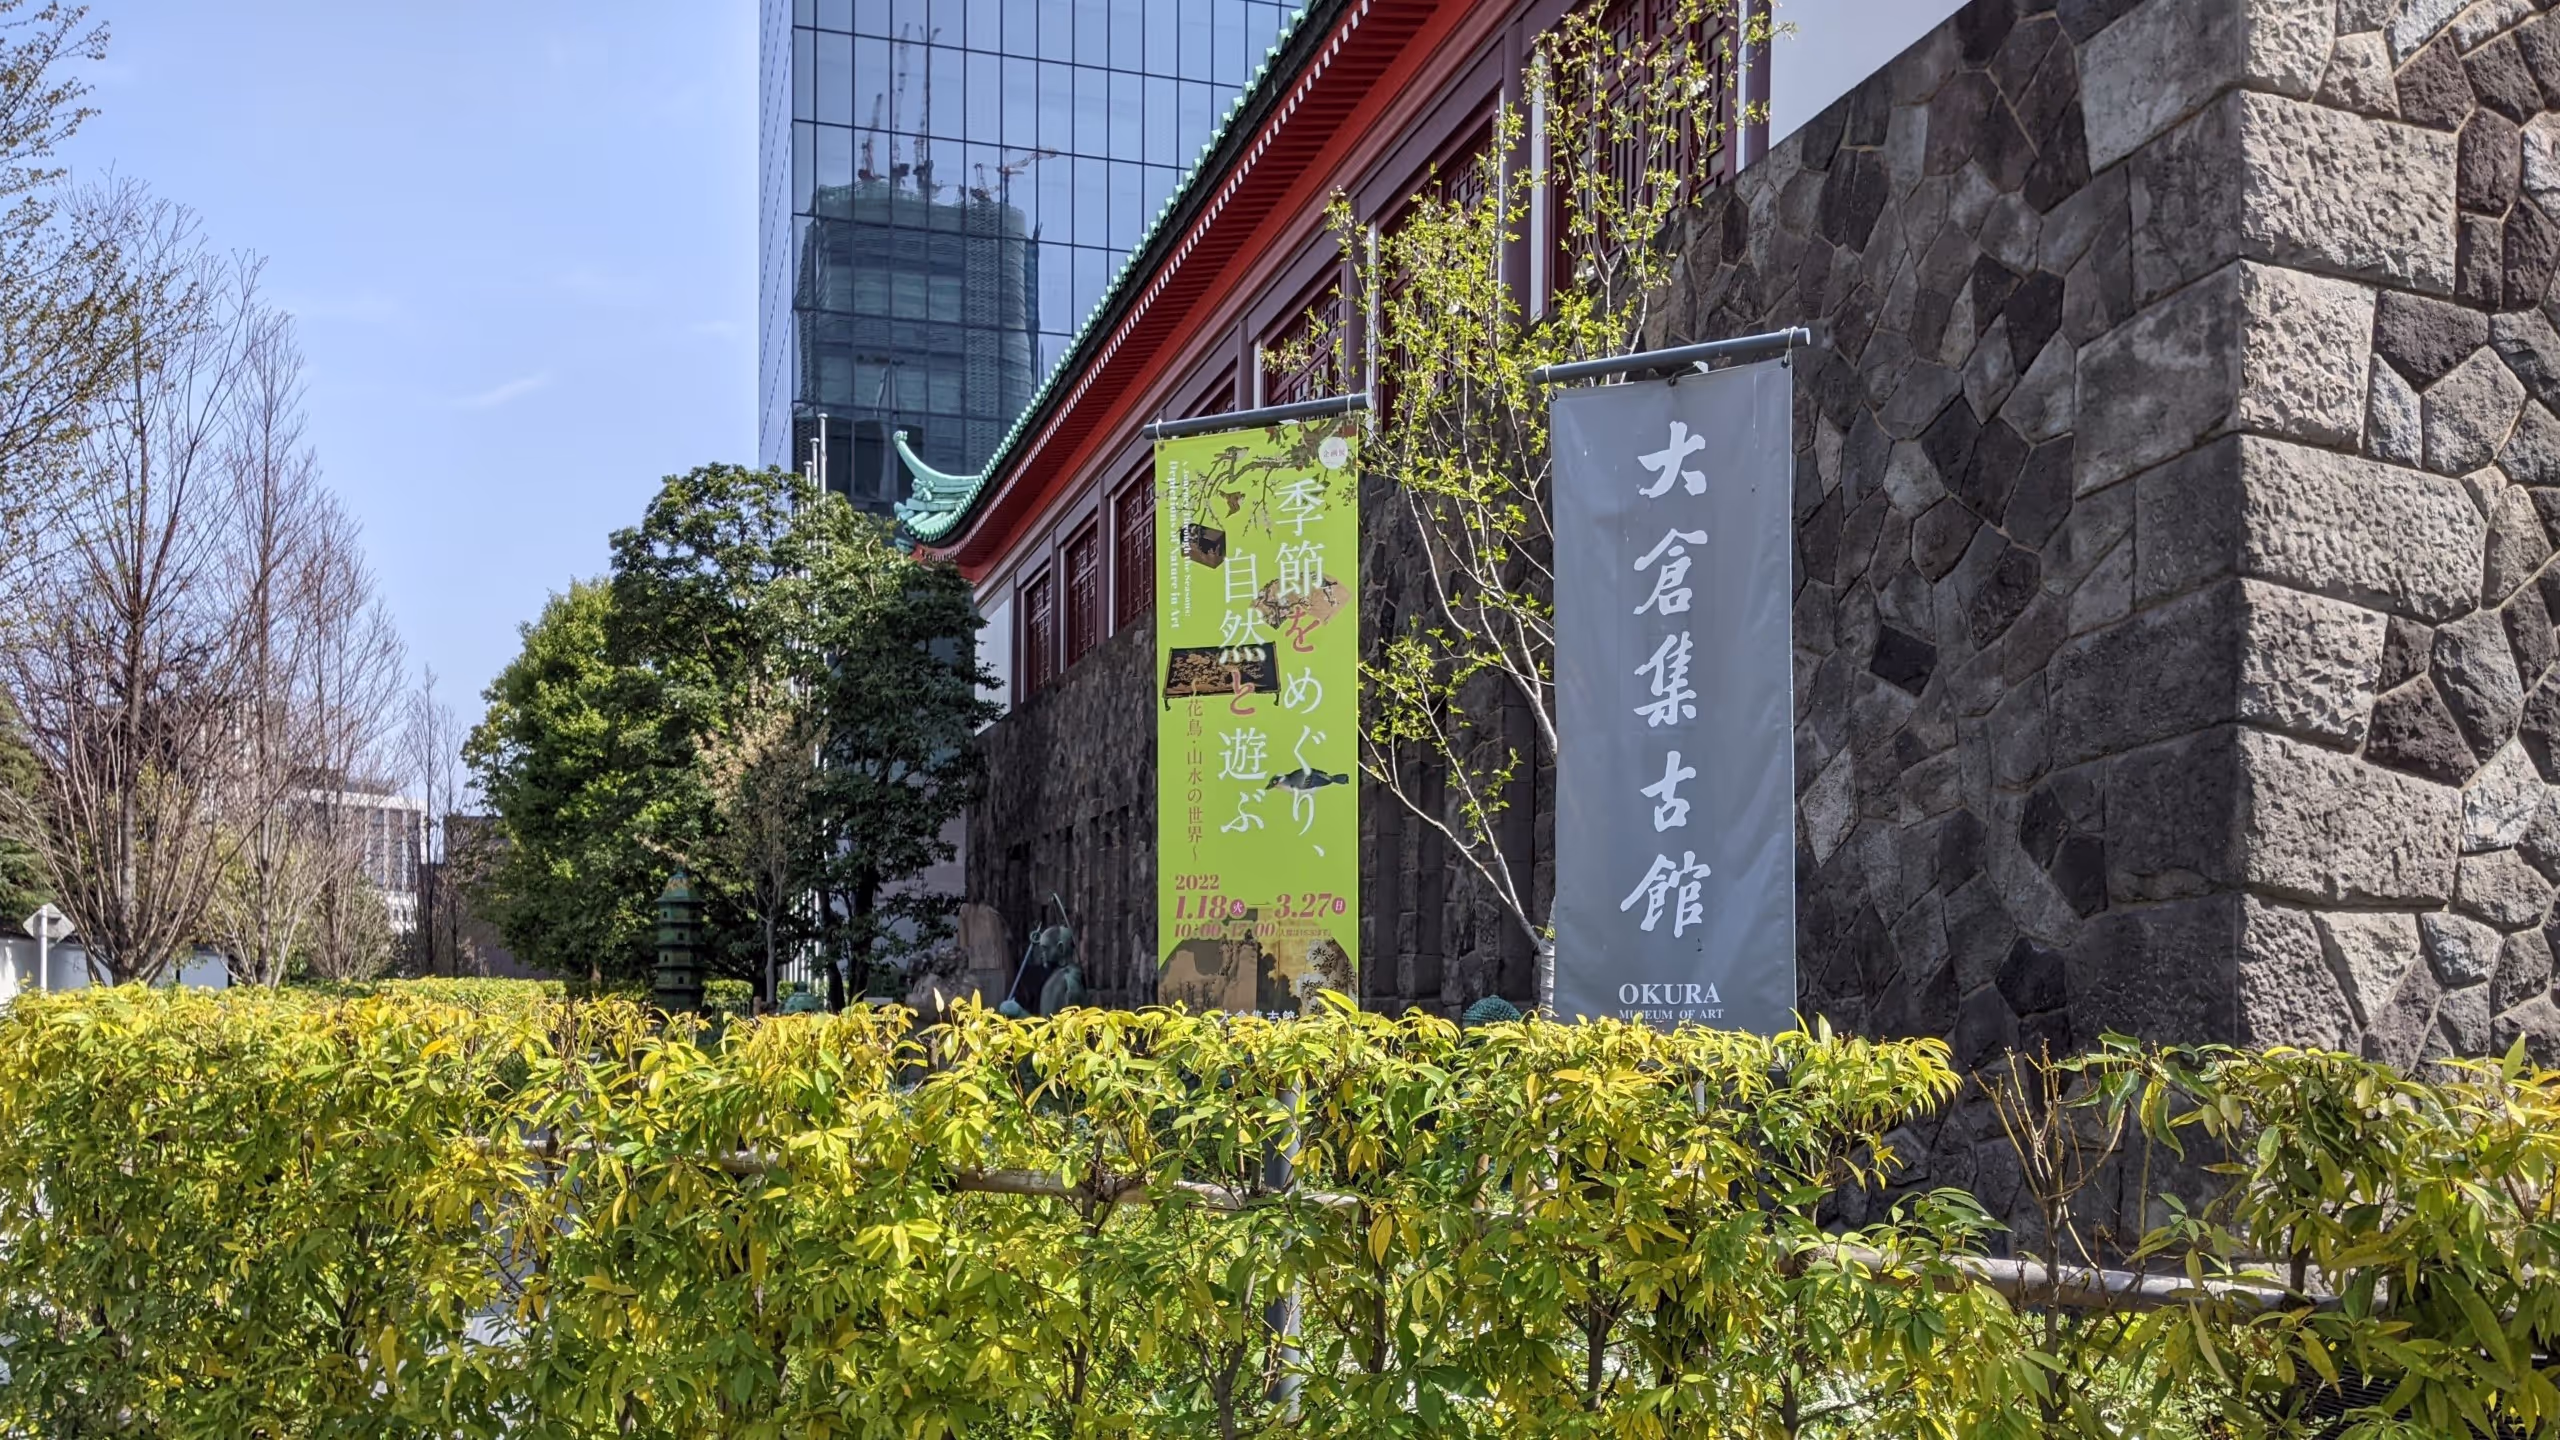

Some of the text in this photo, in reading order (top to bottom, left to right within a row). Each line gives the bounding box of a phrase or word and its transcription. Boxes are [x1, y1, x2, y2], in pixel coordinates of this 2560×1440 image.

[1168, 461, 1181, 629] Depictions of Nature in Art
[1217, 547, 1268, 833] 自然と遊ぶ
[1275, 478, 1327, 858] 季節をめぐり、
[1620, 421, 1711, 938] 大倉集古館
[1175, 874, 1220, 890] 2022
[1618, 981, 1722, 1005] OKURA
[1679, 1008, 1696, 1020] OF
[1700, 1008, 1724, 1019] ART
